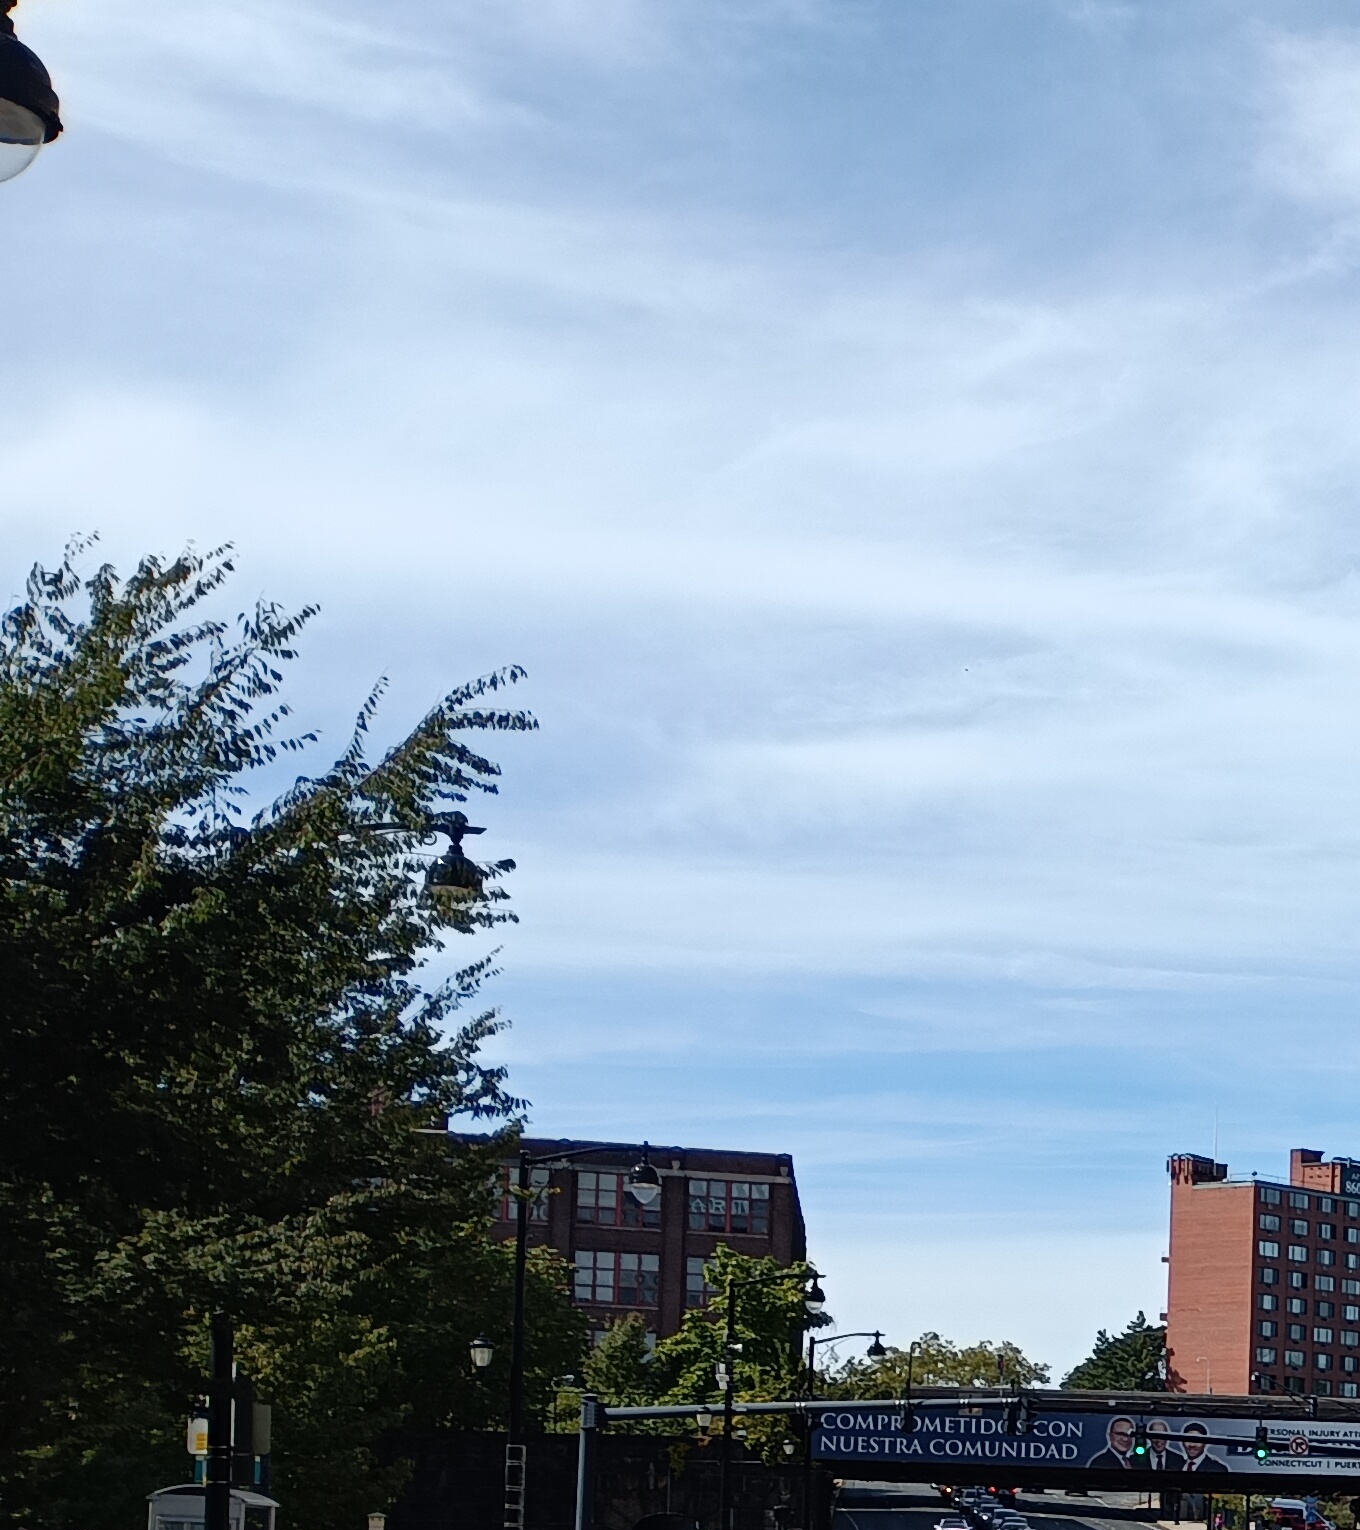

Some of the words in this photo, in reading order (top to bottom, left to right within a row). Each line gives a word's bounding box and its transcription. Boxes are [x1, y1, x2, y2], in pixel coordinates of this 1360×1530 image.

[1032, 1420, 1084, 1437] CON
[1265, 1428, 1307, 1438] ERSONAL
[1308, 1429, 1341, 1438] INJURY
[820, 1435, 923, 1455] NUESTRA
[929, 1438, 1078, 1460] COMUNIDAD
[1258, 1459, 1322, 1468] CONNECTICUT
